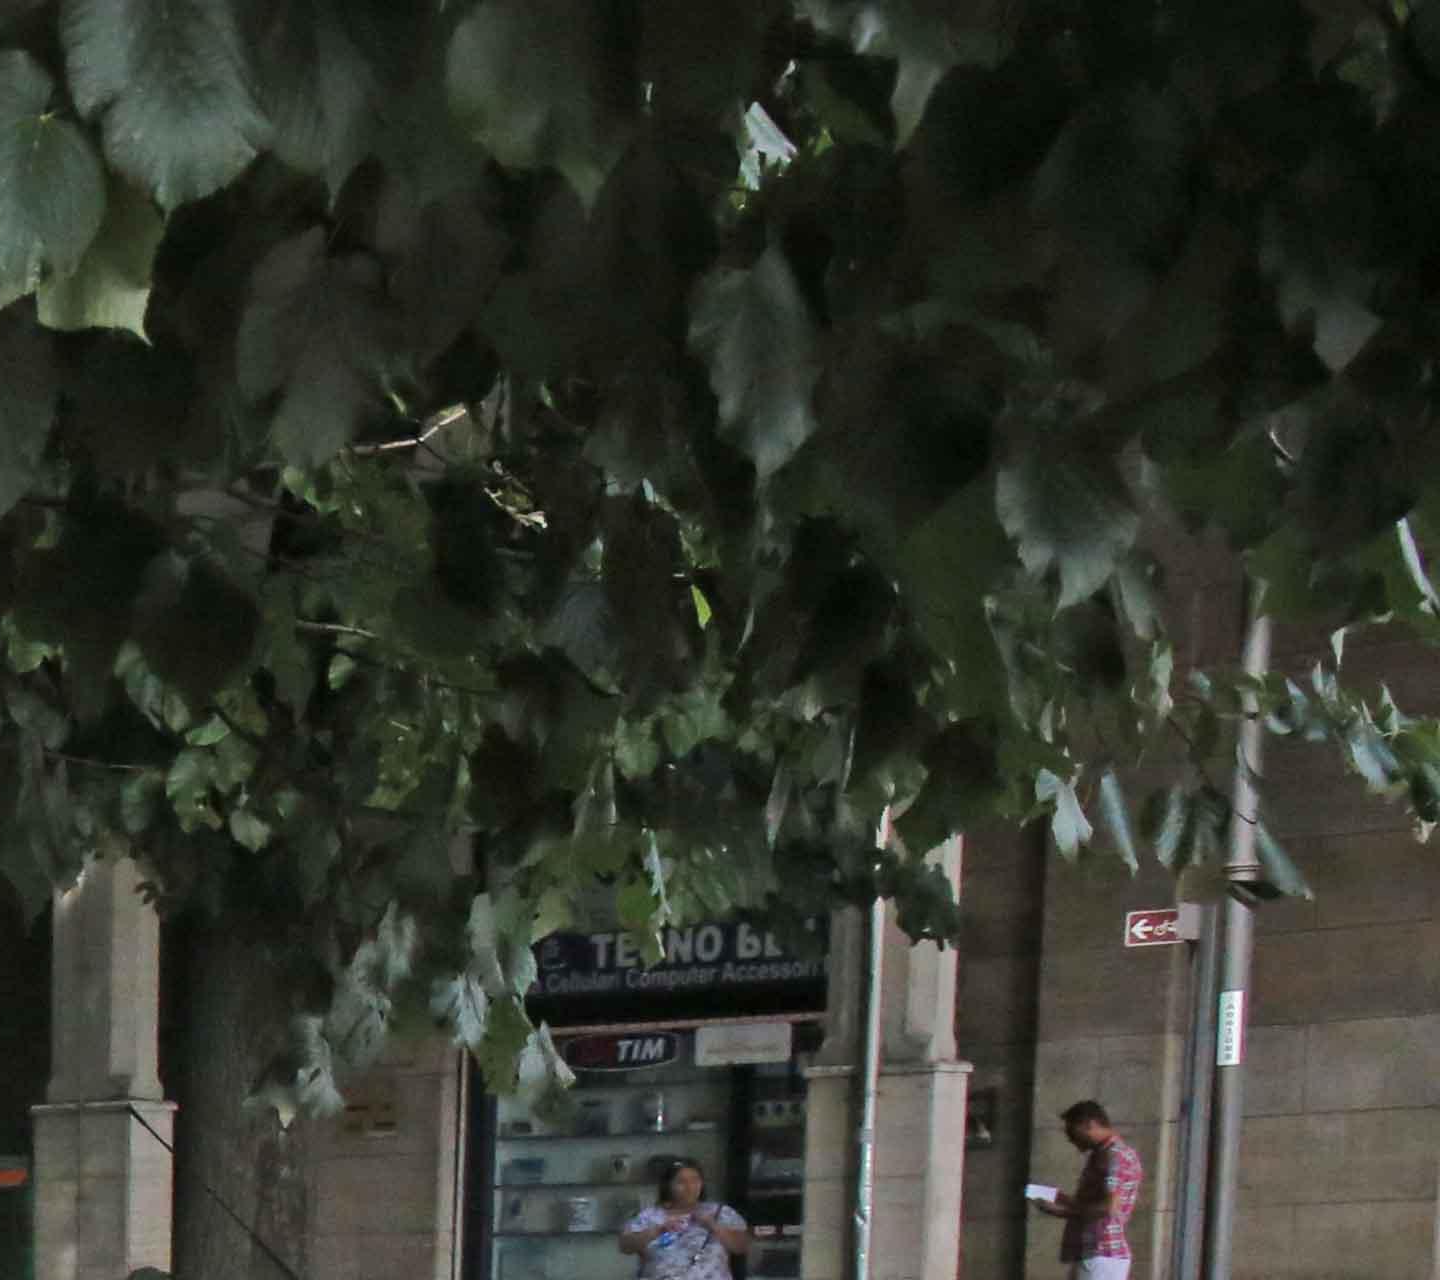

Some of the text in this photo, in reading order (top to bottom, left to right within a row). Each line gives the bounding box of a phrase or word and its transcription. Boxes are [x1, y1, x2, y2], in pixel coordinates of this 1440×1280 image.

[587, 924, 725, 969] TENO
[624, 966, 718, 992] Computer
[615, 1037, 666, 1063] TIM
